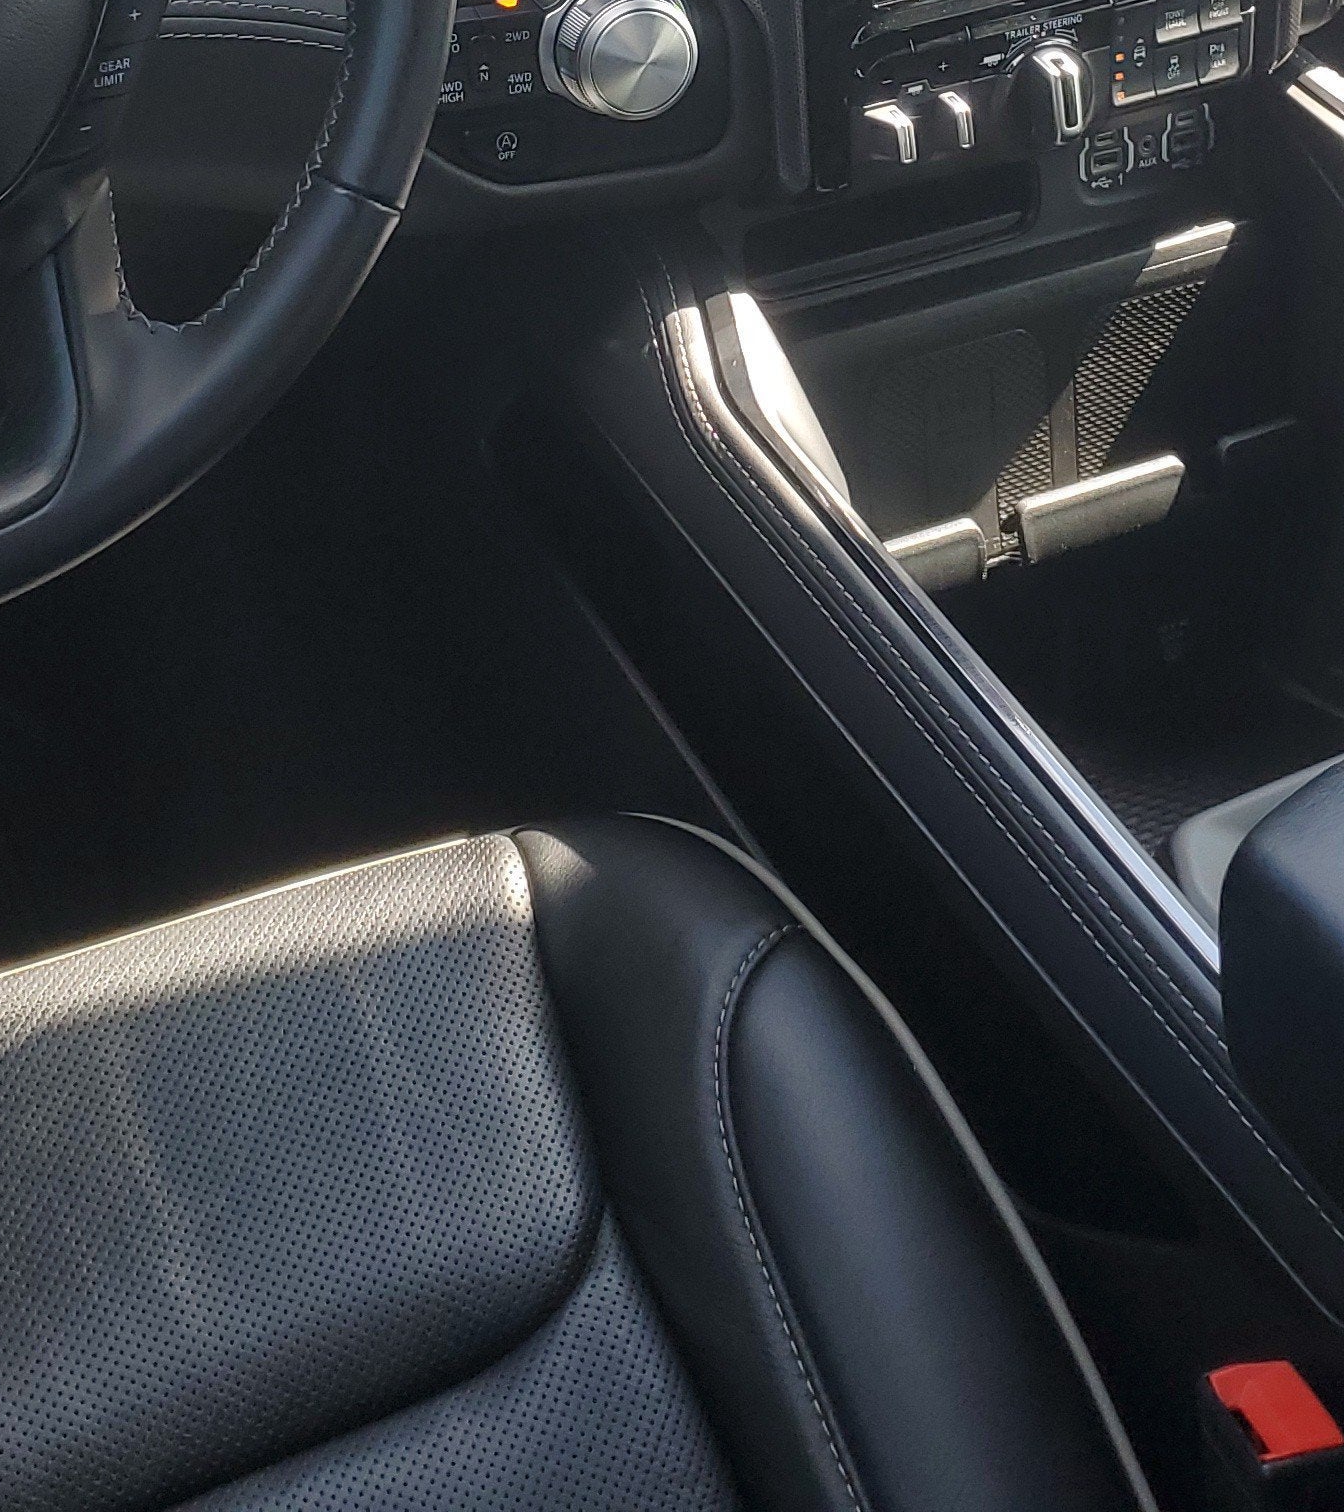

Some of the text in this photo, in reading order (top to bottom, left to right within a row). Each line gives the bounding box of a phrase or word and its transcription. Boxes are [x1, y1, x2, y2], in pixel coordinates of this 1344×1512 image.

[1004, 13, 1083, 42] TRAILER STEERING
[505, 30, 531, 43] 2WD
[98, 57, 131, 73] GEAR
[93, 72, 125, 88] LIMIT
[479, 71, 489, 82] N
[507, 72, 532, 84] 4WD
[508, 83, 533, 94] LOW
[438, 93, 464, 104] HIGH
[498, 151, 516, 161] OFF
[1138, 156, 1157, 169] AUX
